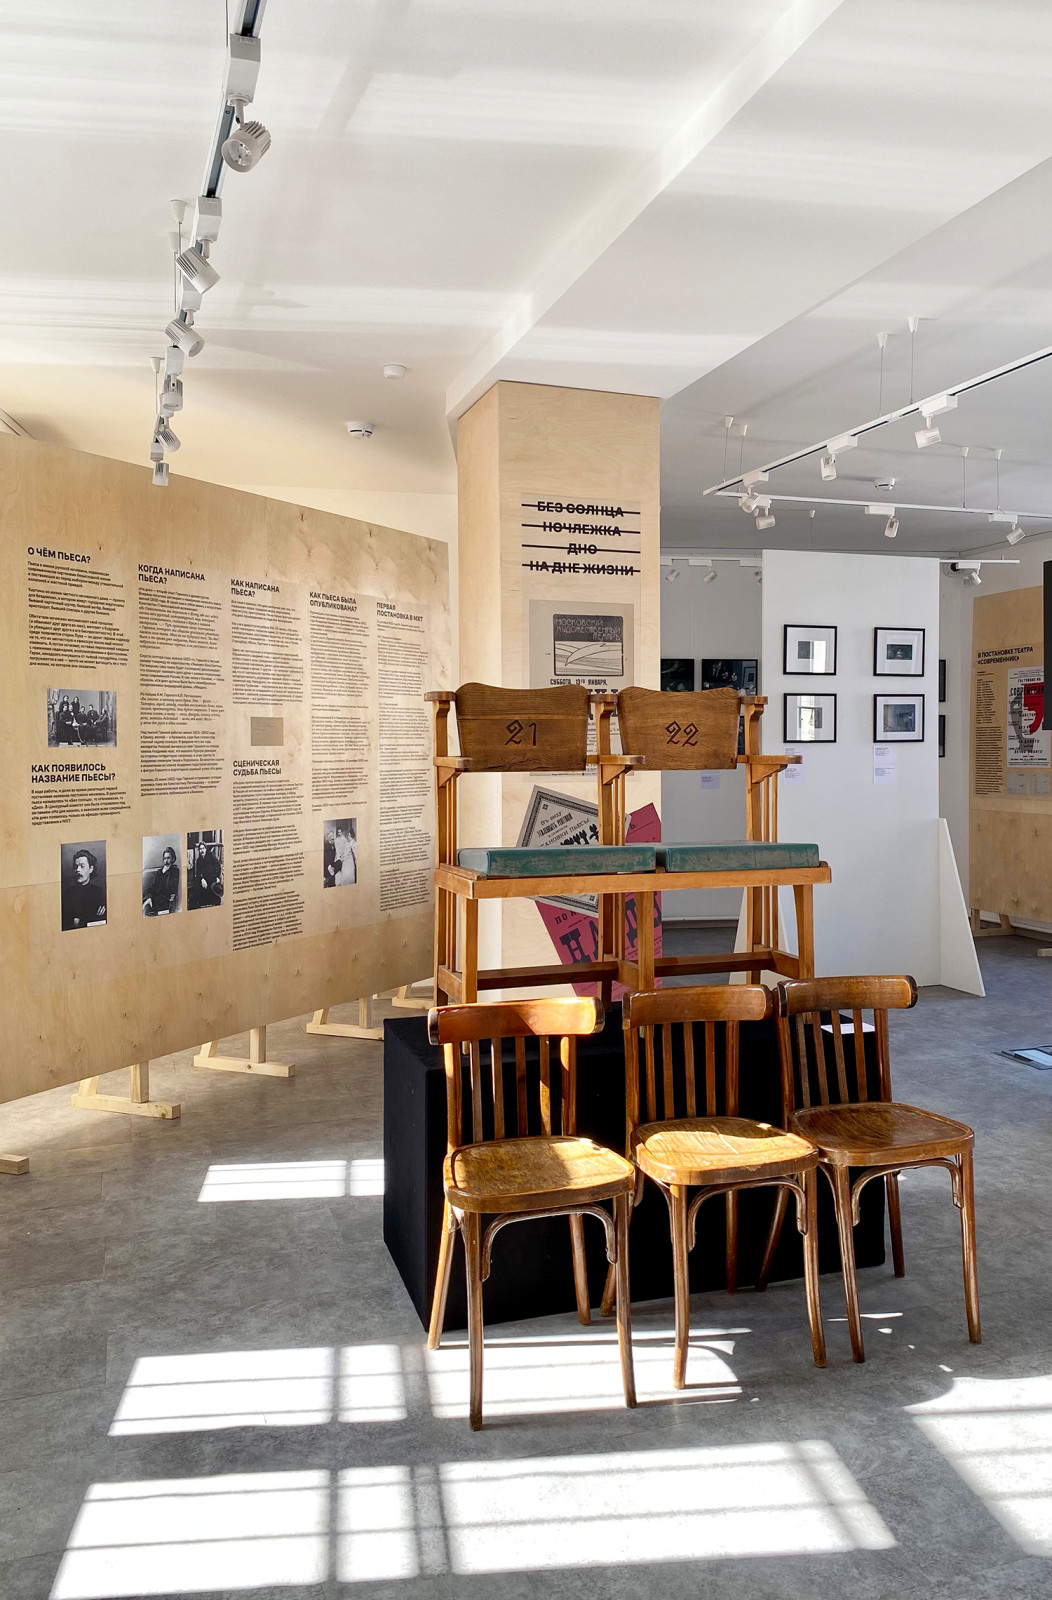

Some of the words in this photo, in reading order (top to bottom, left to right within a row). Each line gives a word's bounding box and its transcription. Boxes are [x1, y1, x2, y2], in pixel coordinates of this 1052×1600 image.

[537, 501, 563, 513] БЕЗ
[566, 503, 624, 518] СОЛНЦА
[543, 522, 621, 536] НОЧЛЕЖКА
[567, 543, 598, 555] ДНО
[27, 547, 35, 555] О
[36, 547, 56, 558] ЧЁМ
[57, 551, 91, 564] ПЬЕСА?
[138, 564, 164, 575] КОГДА
[164, 568, 206, 581] НАПИСАНА
[530, 560, 549, 571] НА
[552, 562, 580, 574] ДНЕ
[582, 564, 634, 576] ЖИЗНИ
[138, 573, 168, 584] ПЬЕСА?
[230, 579, 245, 588] КАК
[244, 580, 280, 593] НАПИСАНА
[231, 587, 256, 598] ПЬЕСА?
[309, 591, 322, 600] КАК
[321, 593, 341, 602] ПЬЕСА
[340, 596, 357, 605] БЫЛА
[309, 599, 358, 612] ОПУБЛИКОВАНА?
[376, 602, 396, 610] ПЕРВАЯ
[376, 609, 409, 620] ПОСТАНОВКА
[981, 649, 1014, 658] ПОСТАНОВКЕ
[1014, 646, 1034, 655] ТЕАТРА
[505, 719, 537, 747] 21
[665, 720, 699, 747] 22
[31, 764, 50, 773] КАК
[51, 763, 106, 773] ПОЯВИЛОСЬ
[232, 760, 280, 768] СЦЕНИЧЕСКАЯ
[31, 774, 80, 784] НАЗВАНИЕ
[81, 773, 116, 782] ПЬЕСЫ?
[232, 768, 259, 777] СУДЬБА
[259, 768, 282, 776] ПЬЕСЫ
